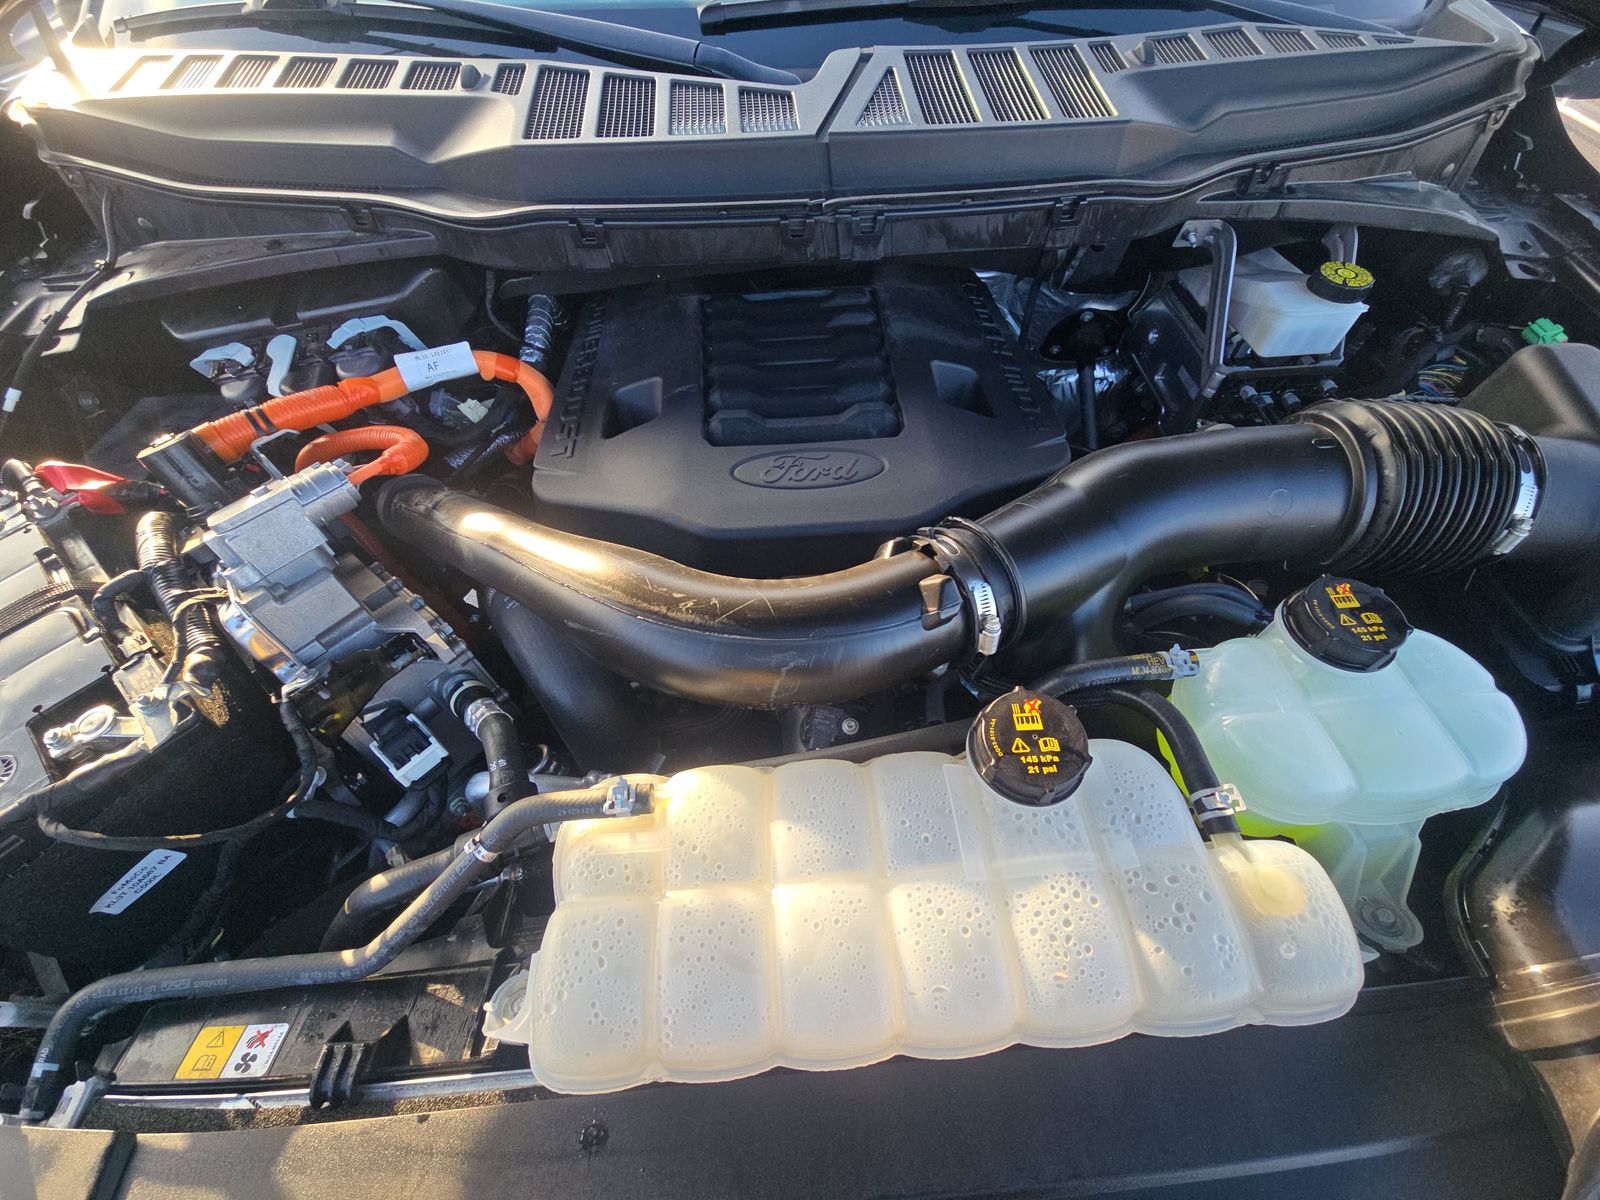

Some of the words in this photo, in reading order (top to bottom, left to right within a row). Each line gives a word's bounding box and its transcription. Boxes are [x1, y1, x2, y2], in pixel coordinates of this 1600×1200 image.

[427, 361, 440, 372] AF
[761, 454, 860, 484] Ford
[1374, 633, 1387, 641] psi
[1147, 655, 1166, 666] HEV
[1020, 755, 1039, 764] 145
[1040, 754, 1060, 763] kPa
[1027, 766, 1040, 774] 21
[1042, 764, 1058, 775] psi
[157, 854, 172, 865] BA
[111, 866, 148, 895] FoMoCo
